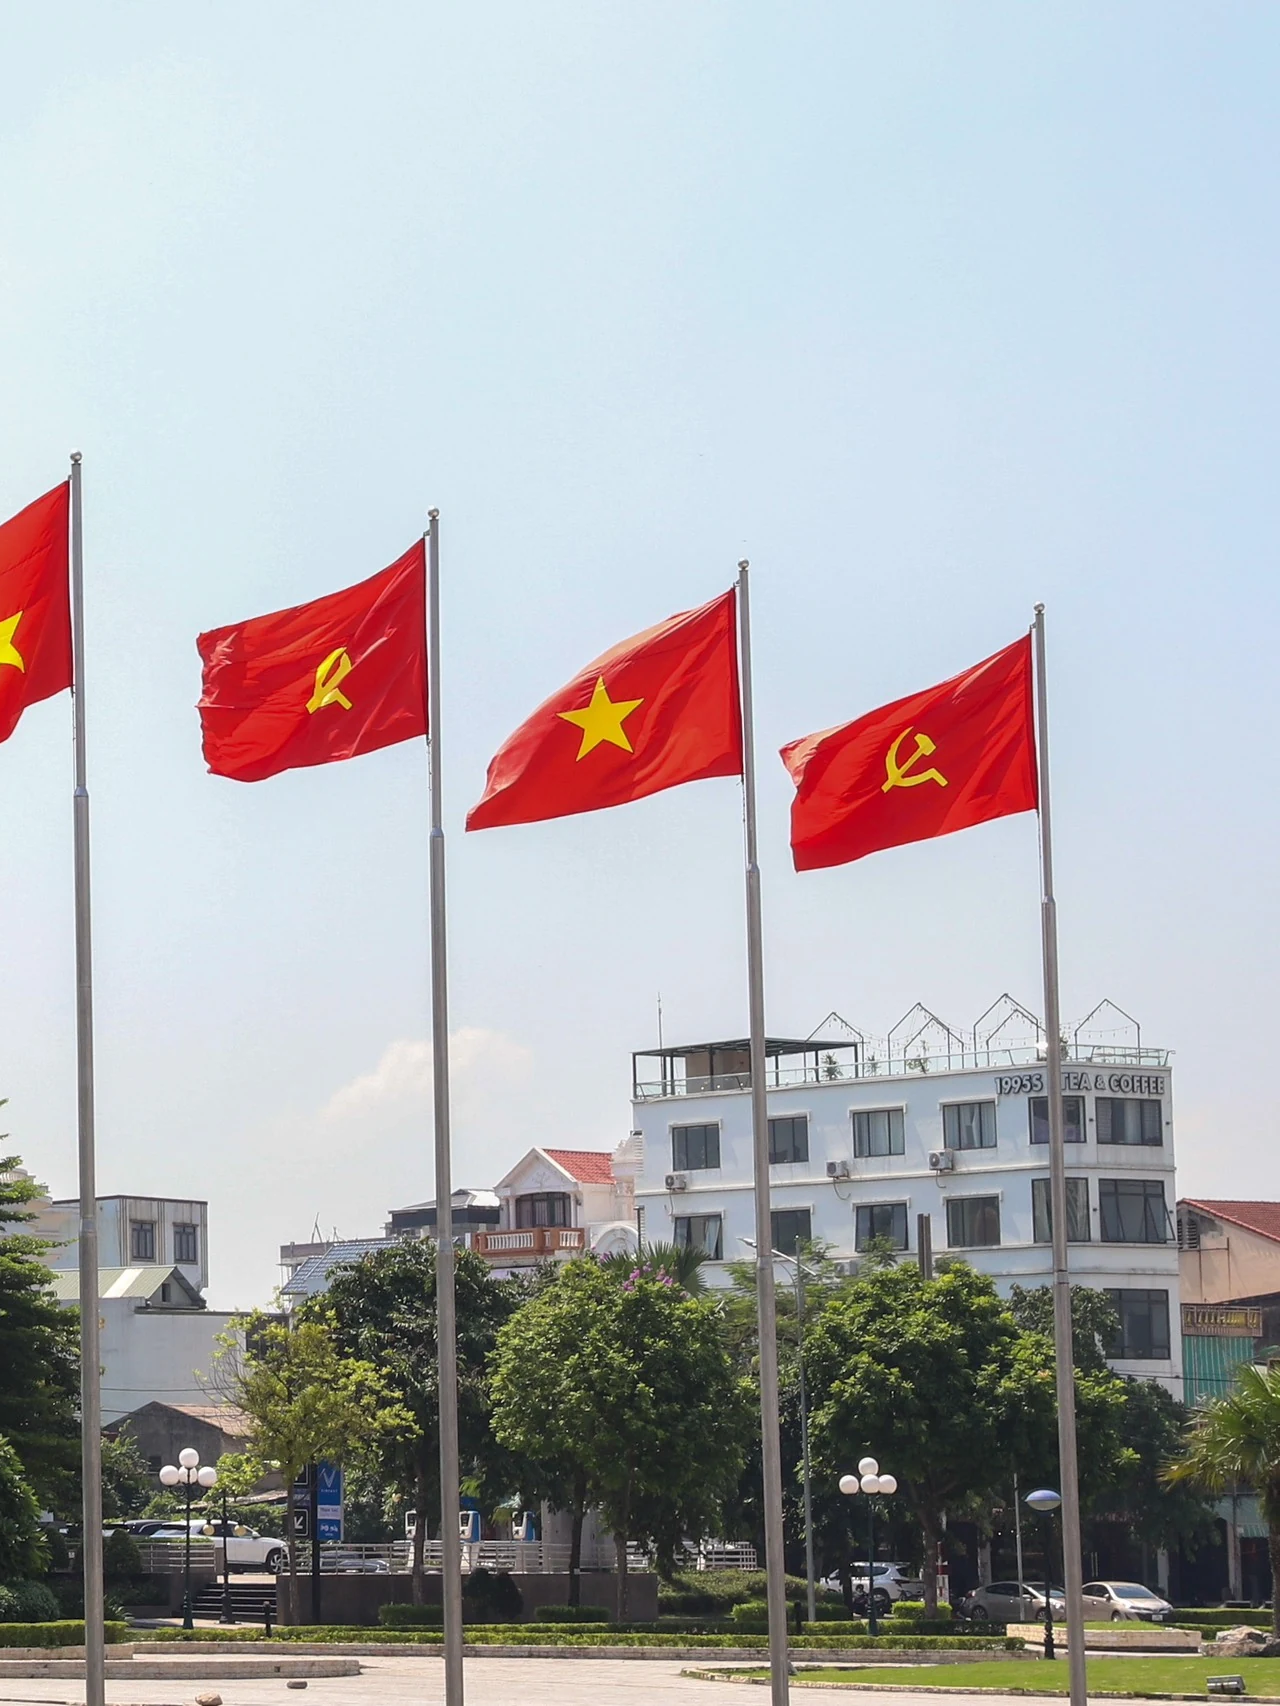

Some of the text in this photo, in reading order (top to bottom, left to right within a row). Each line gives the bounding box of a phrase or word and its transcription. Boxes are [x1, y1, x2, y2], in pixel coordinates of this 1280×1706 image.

[995, 1072, 1165, 1095] 1995S TEA & COFFEE
